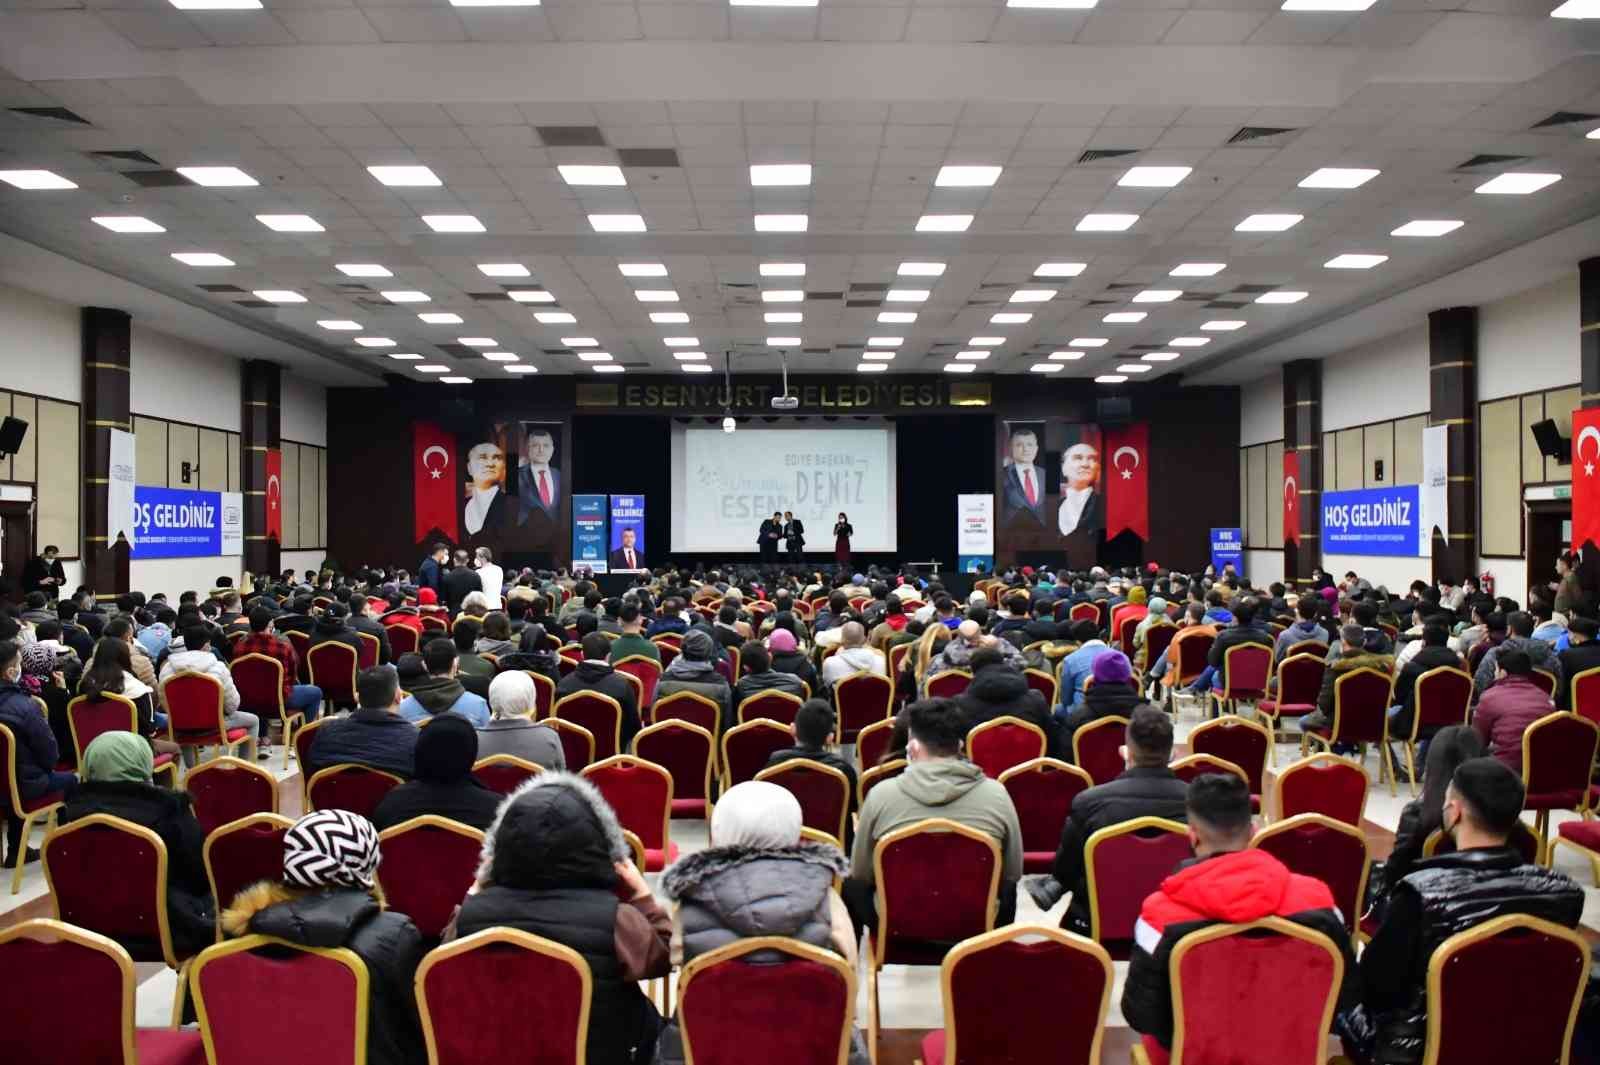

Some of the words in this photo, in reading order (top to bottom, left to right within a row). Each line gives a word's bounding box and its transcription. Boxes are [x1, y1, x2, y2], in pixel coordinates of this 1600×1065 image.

[625, 384, 771, 407] ESENYURT
[796, 470, 865, 505] DENİZ
[132, 502, 151, 534] OŞ
[153, 500, 215, 529] GELDİNİZ
[1324, 505, 1349, 533] HOŞ
[1351, 497, 1411, 527] GELDİNİZ
